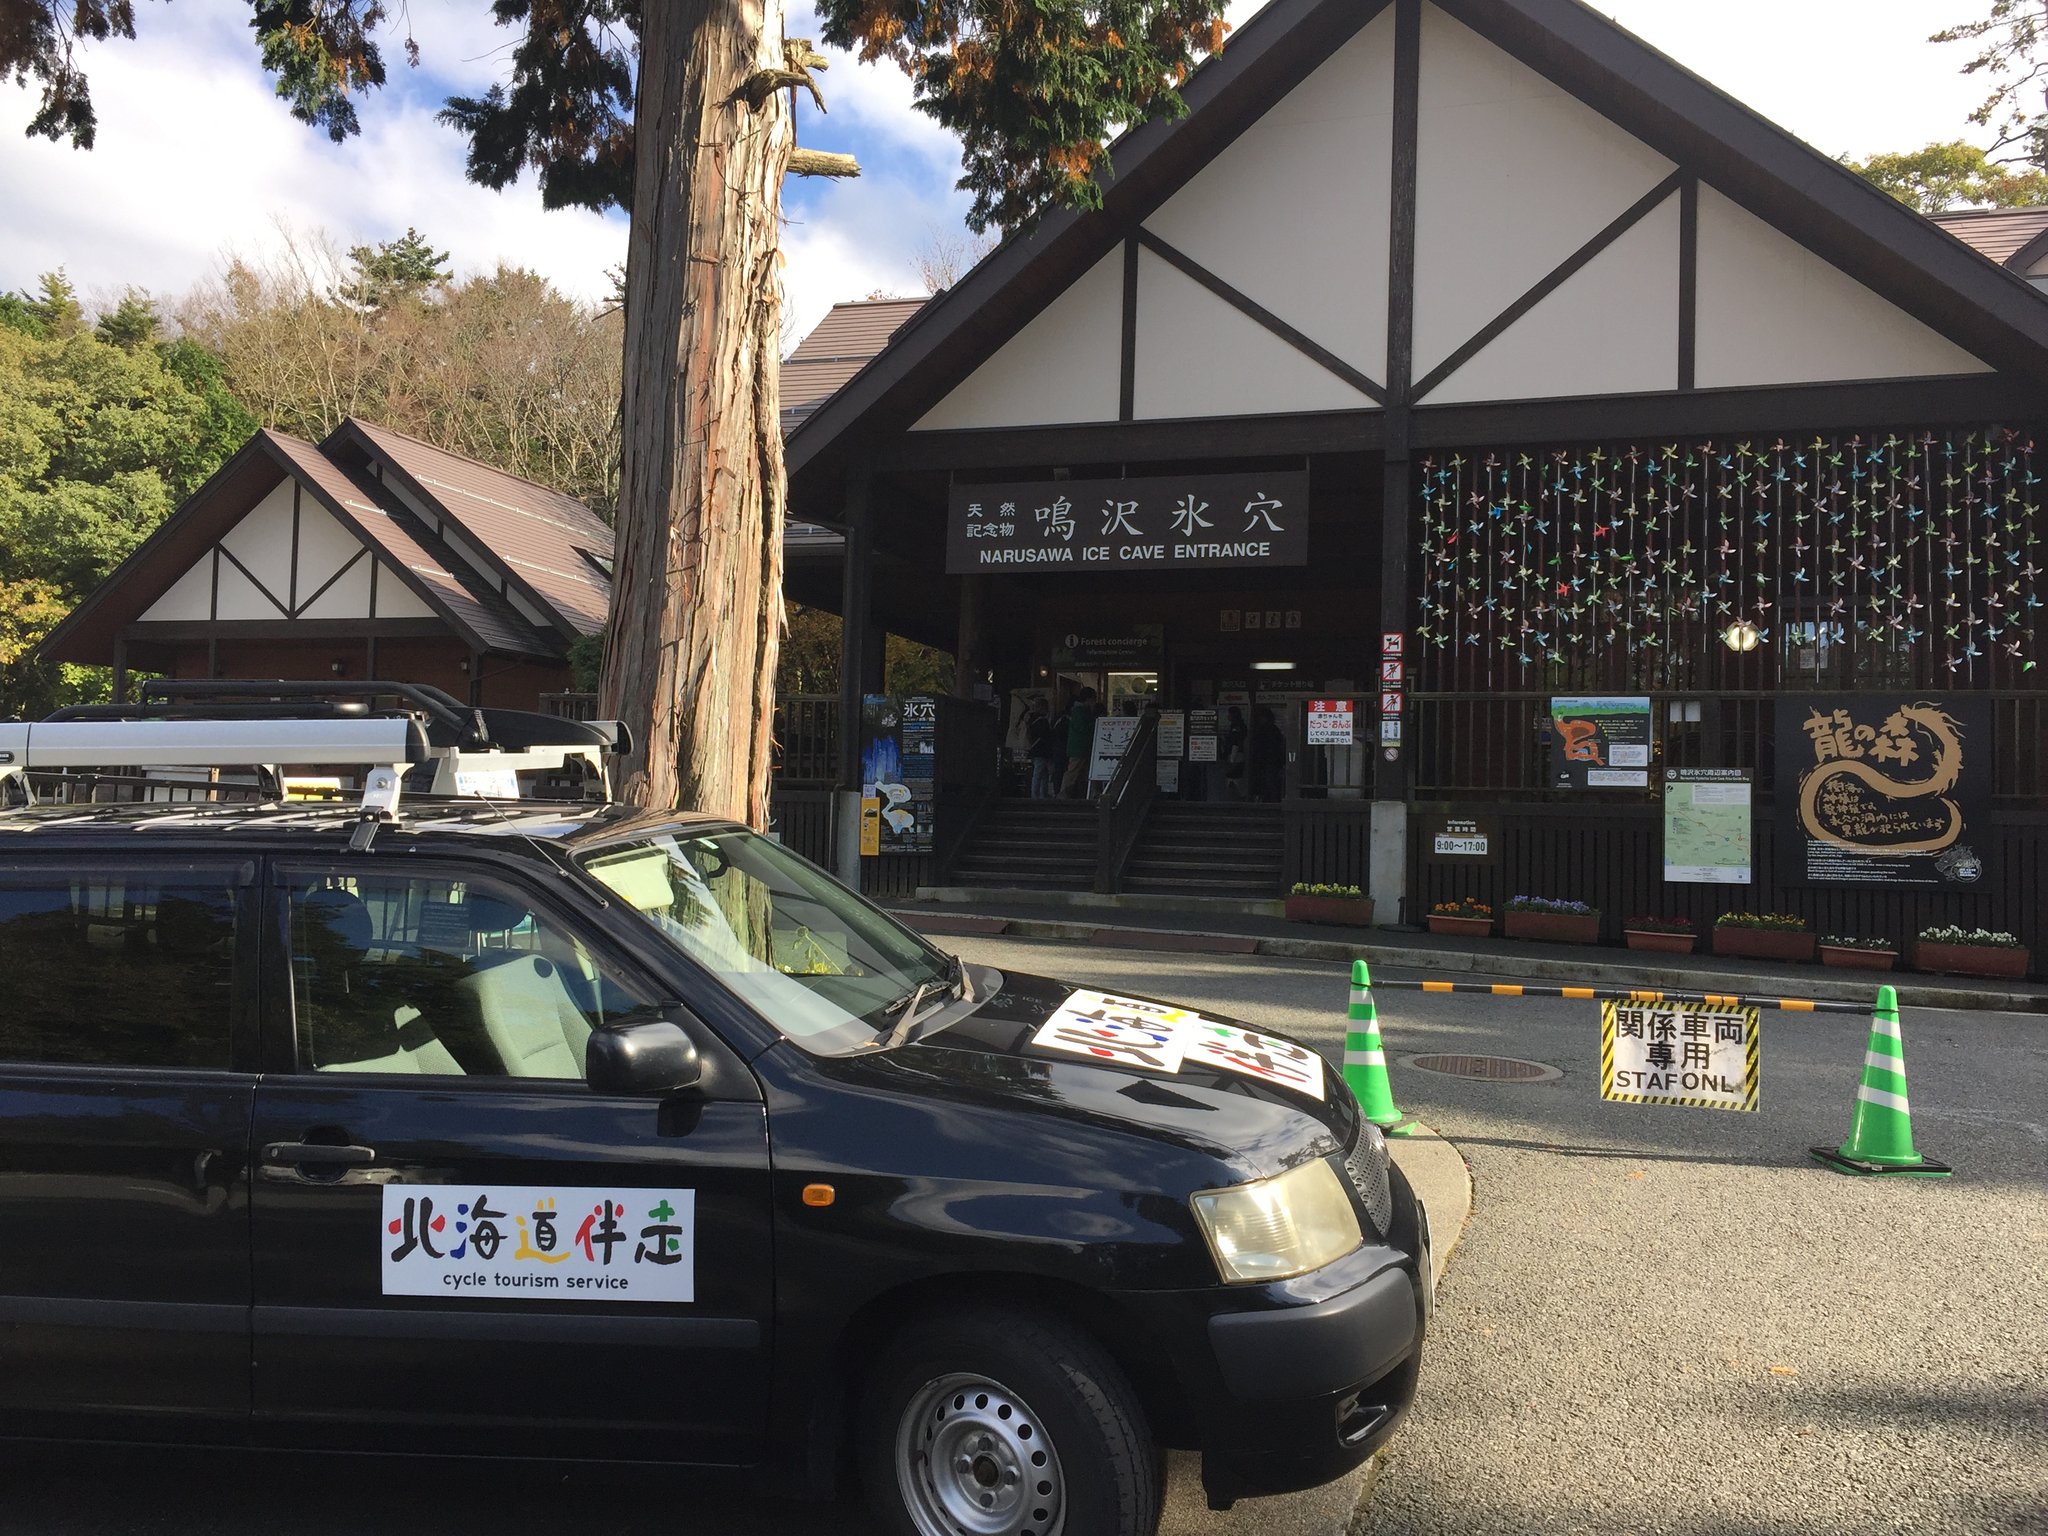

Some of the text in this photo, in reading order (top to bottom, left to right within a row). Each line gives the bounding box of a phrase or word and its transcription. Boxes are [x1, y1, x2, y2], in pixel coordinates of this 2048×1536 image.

[967, 491, 1285, 541] 天然 鳴沢氷穴
[966, 522, 1015, 538] 記念物
[979, 542, 1270, 564] NARUSAWA ICE CAVE ENTRANCE
[1081, 637, 1148, 647] Forest concierge
[903, 703, 936, 717] 氷穴
[1314, 701, 1347, 712] 注意
[1802, 706, 1920, 767] 龍の森
[1616, 1010, 1744, 1045] 関係車両
[1646, 1041, 1710, 1070] 専用
[388, 1194, 683, 1265] 北海道伴走
[443, 1272, 628, 1290] cycle tourism service
